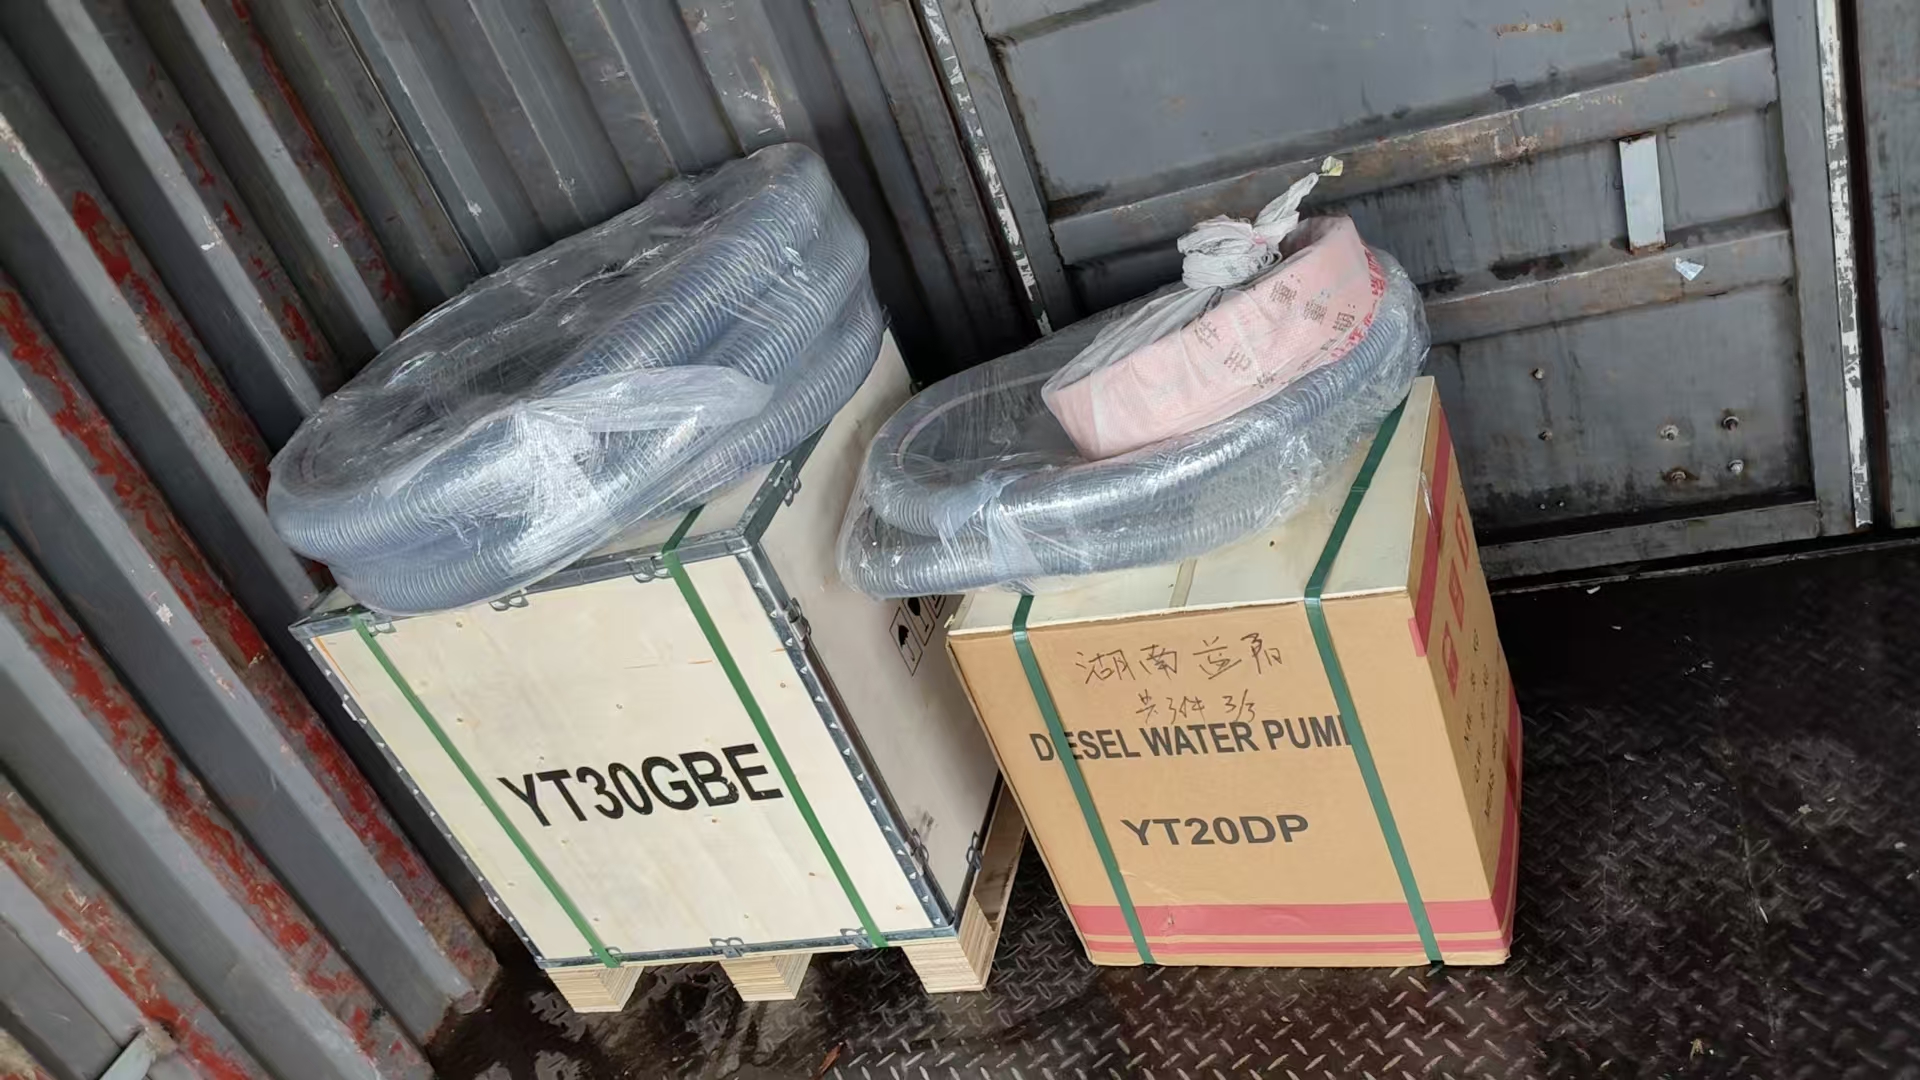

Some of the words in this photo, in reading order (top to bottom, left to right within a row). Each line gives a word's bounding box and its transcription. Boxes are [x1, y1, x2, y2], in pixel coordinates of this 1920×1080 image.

[1221, 689, 1257, 723] 3/3
[1029, 729, 1142, 762] DESEL
[1139, 721, 1260, 757] WATER
[497, 743, 784, 827] YT30GBE
[1121, 814, 1309, 846] YT20DP
